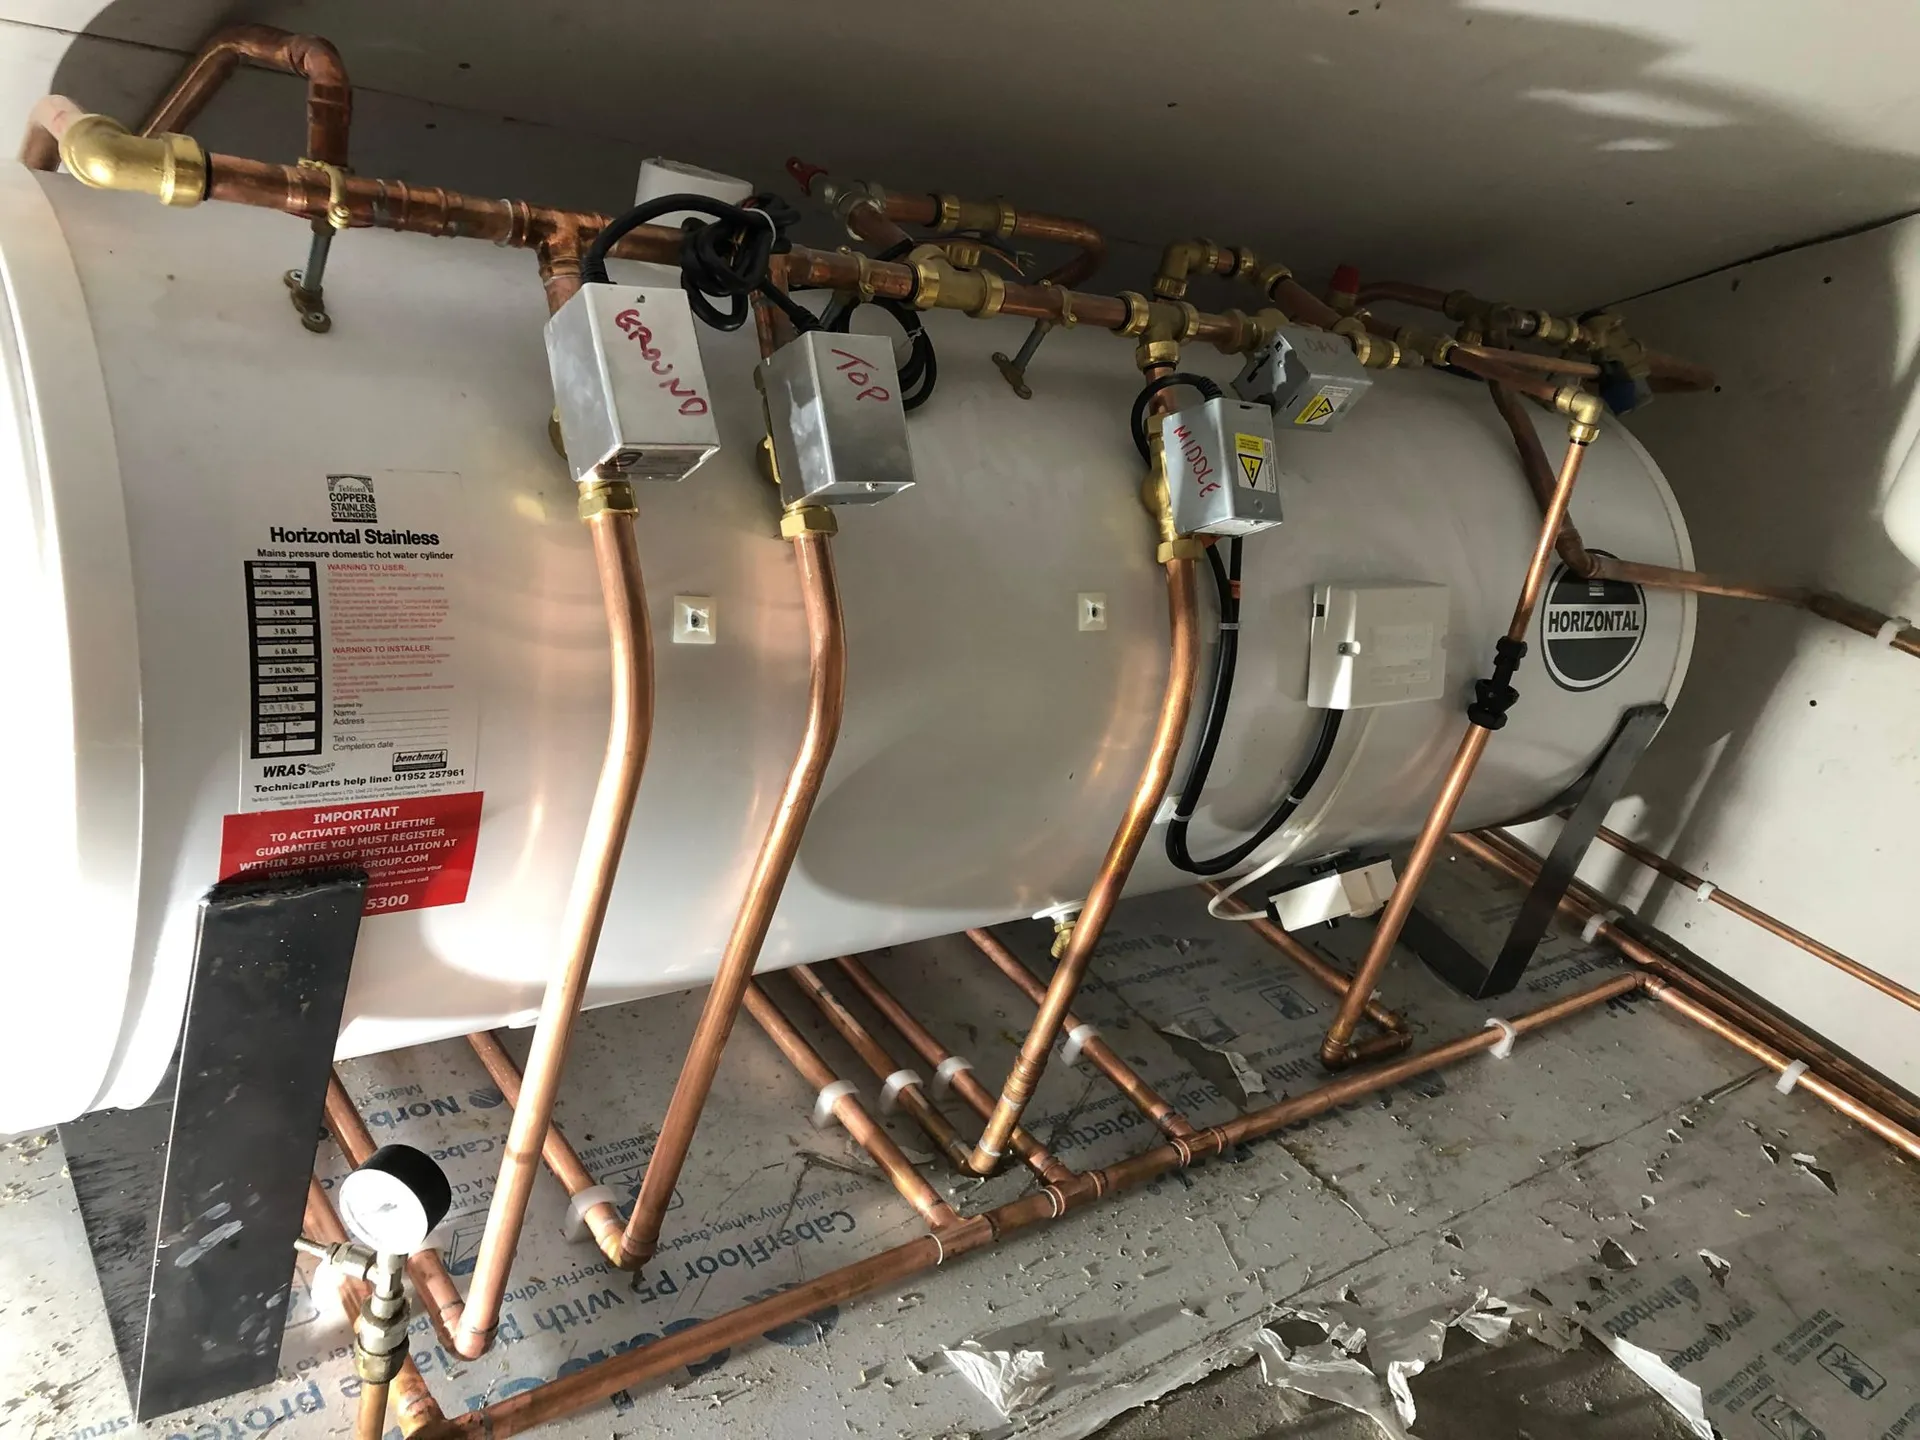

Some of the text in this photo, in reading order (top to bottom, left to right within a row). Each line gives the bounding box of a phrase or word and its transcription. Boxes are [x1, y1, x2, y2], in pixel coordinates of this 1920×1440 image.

[614, 308, 708, 416] GROUND
[830, 348, 890, 401] TOP
[1173, 425, 1221, 497] MIDDLE
[330, 503, 377, 513] STAINLESS
[331, 511, 377, 519] CYLINDERS
[270, 526, 440, 546] Horizontal Stainless
[257, 548, 454, 561] Mains pressure domestic hot water cylinder
[327, 563, 367, 571] WARNING
[369, 563, 380, 571] TO
[279, 608, 296, 617] BAR
[1548, 610, 1640, 633] HORIZONTAL
[280, 627, 297, 635] BAR
[281, 647, 298, 655] BAR
[332, 646, 372, 654] WARNING
[281, 685, 299, 693] BAR
[333, 709, 357, 717] Name
[333, 717, 365, 725] Address
[332, 741, 376, 751] Completion
[395, 750, 444, 763] benchmark
[254, 769, 465, 793] Technical/Parts help line: 01952 257961
[263, 763, 307, 778] WRAS
[312, 806, 400, 825] IMPORTANT
[270, 817, 436, 842] TO ACTIVATE YOUR LIFETIME
[256, 828, 445, 858] GUARANTEE YOU MUST REGISTER
[239, 838, 457, 872] WITHIN 28 DAYS OF INSTALLATION AT
[365, 894, 409, 911] 5300
[366, 1095, 462, 1130] Norb
[757, 1198, 791, 1223] only
[795, 1188, 831, 1211] valid
[711, 1211, 759, 1239] when
[672, 1227, 710, 1252] used
[684, 1210, 857, 1283] CaberFloor
[551, 1262, 615, 1292] aberFix
[633, 1268, 678, 1305] P5
[502, 1281, 549, 1305] adhe
[535, 1288, 625, 1334] with
